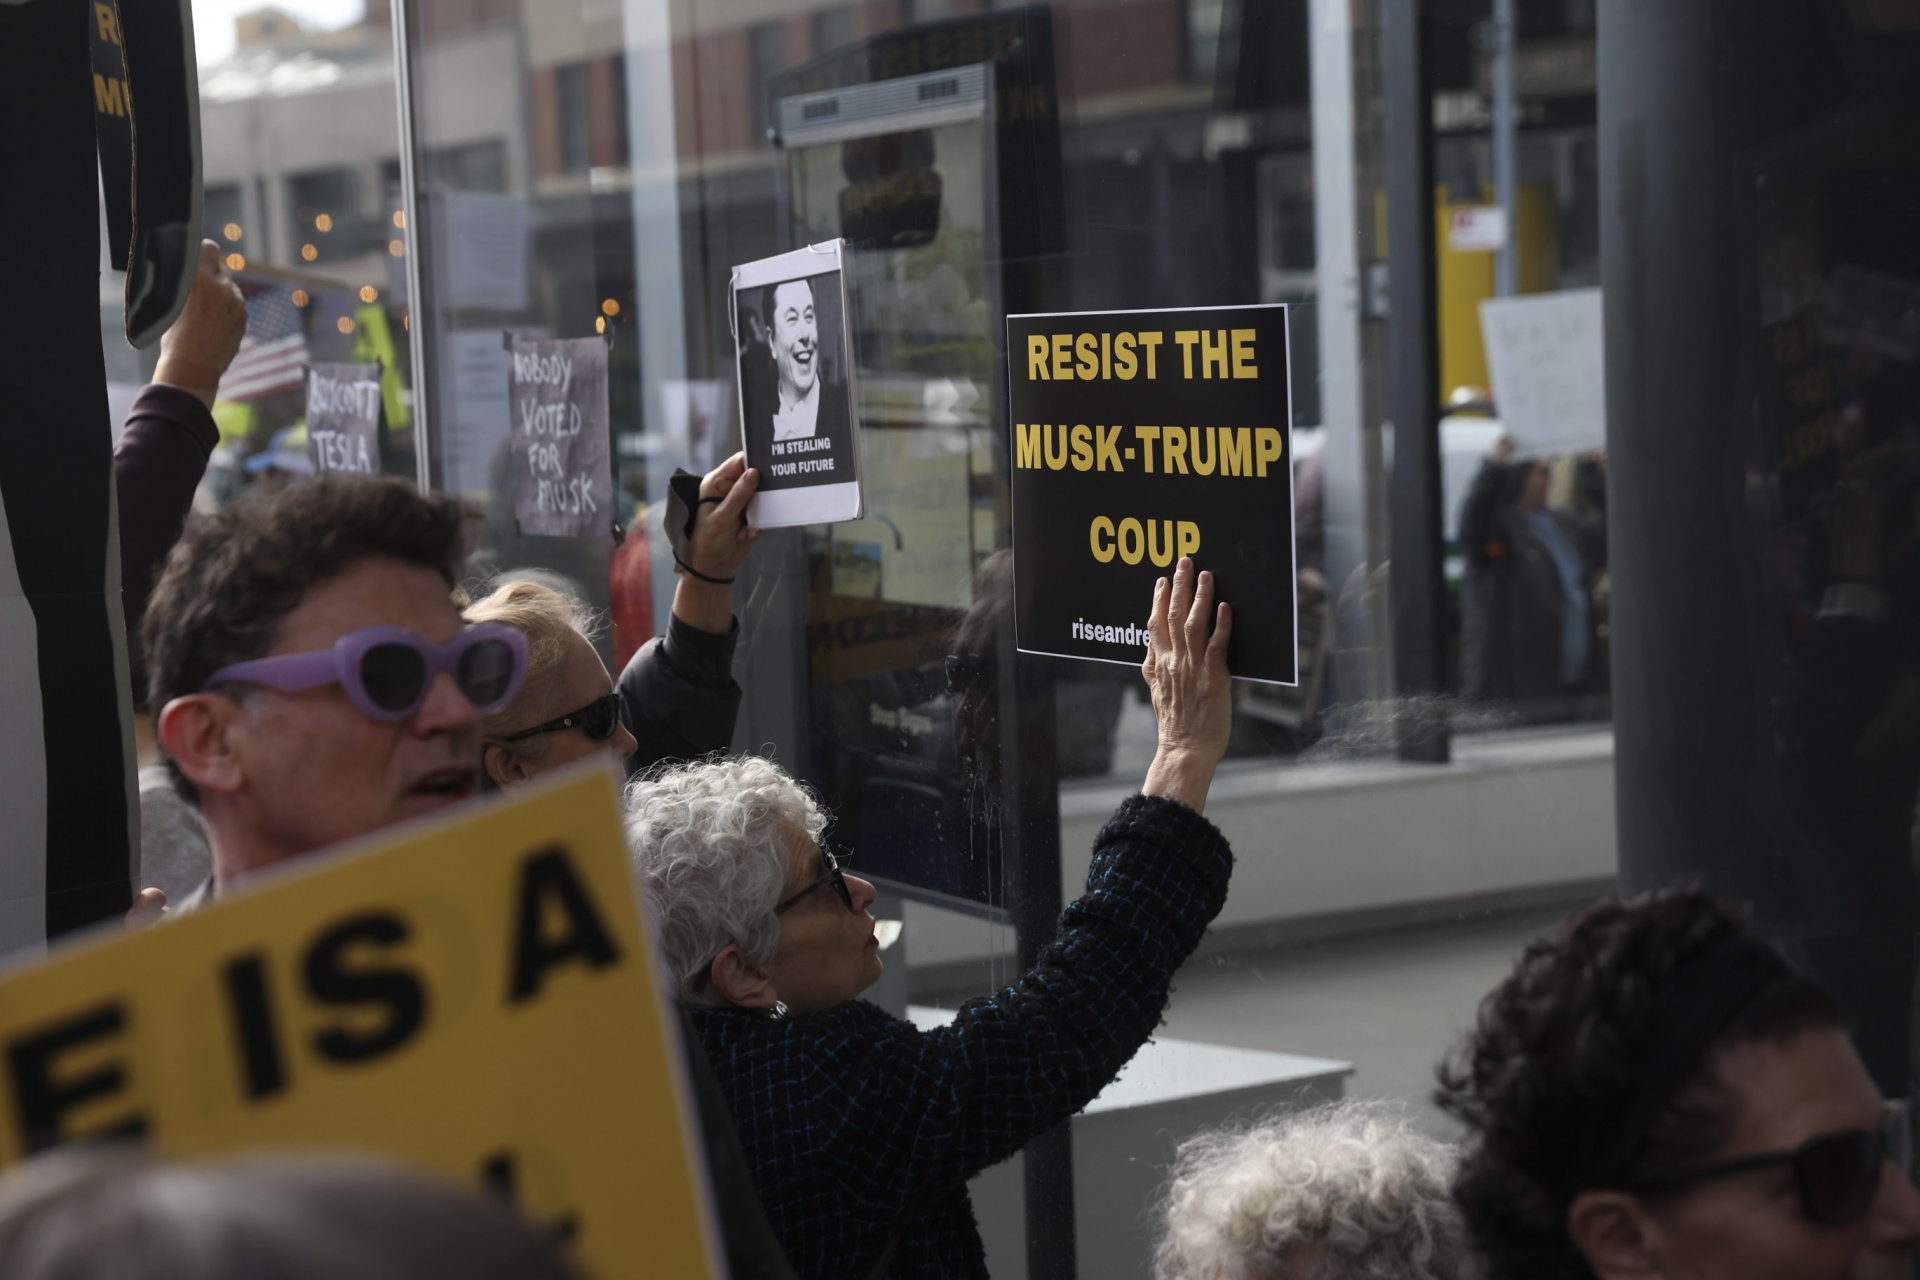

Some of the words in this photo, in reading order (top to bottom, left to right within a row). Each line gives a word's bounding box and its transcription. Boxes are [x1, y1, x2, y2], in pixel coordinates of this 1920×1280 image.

[514, 352, 571, 393] NOBODY
[1028, 331, 1163, 381] RESIST
[1175, 328, 1258, 379] THE
[310, 369, 380, 420] BOYCOTT
[521, 398, 581, 438] VOTED
[311, 430, 371, 474] TESLA
[528, 442, 564, 477] FOR
[771, 443, 785, 456] I'M
[786, 437, 831, 454] STEALING
[771, 463, 797, 477] YOUR
[798, 458, 835, 474] FUTURE
[1016, 424, 1282, 477] MUSK-TRUMP
[539, 472, 597, 515] MUSK
[1090, 515, 1201, 568] COUP
[217, 905, 433, 1108] IS
[503, 840, 626, 1012] A
